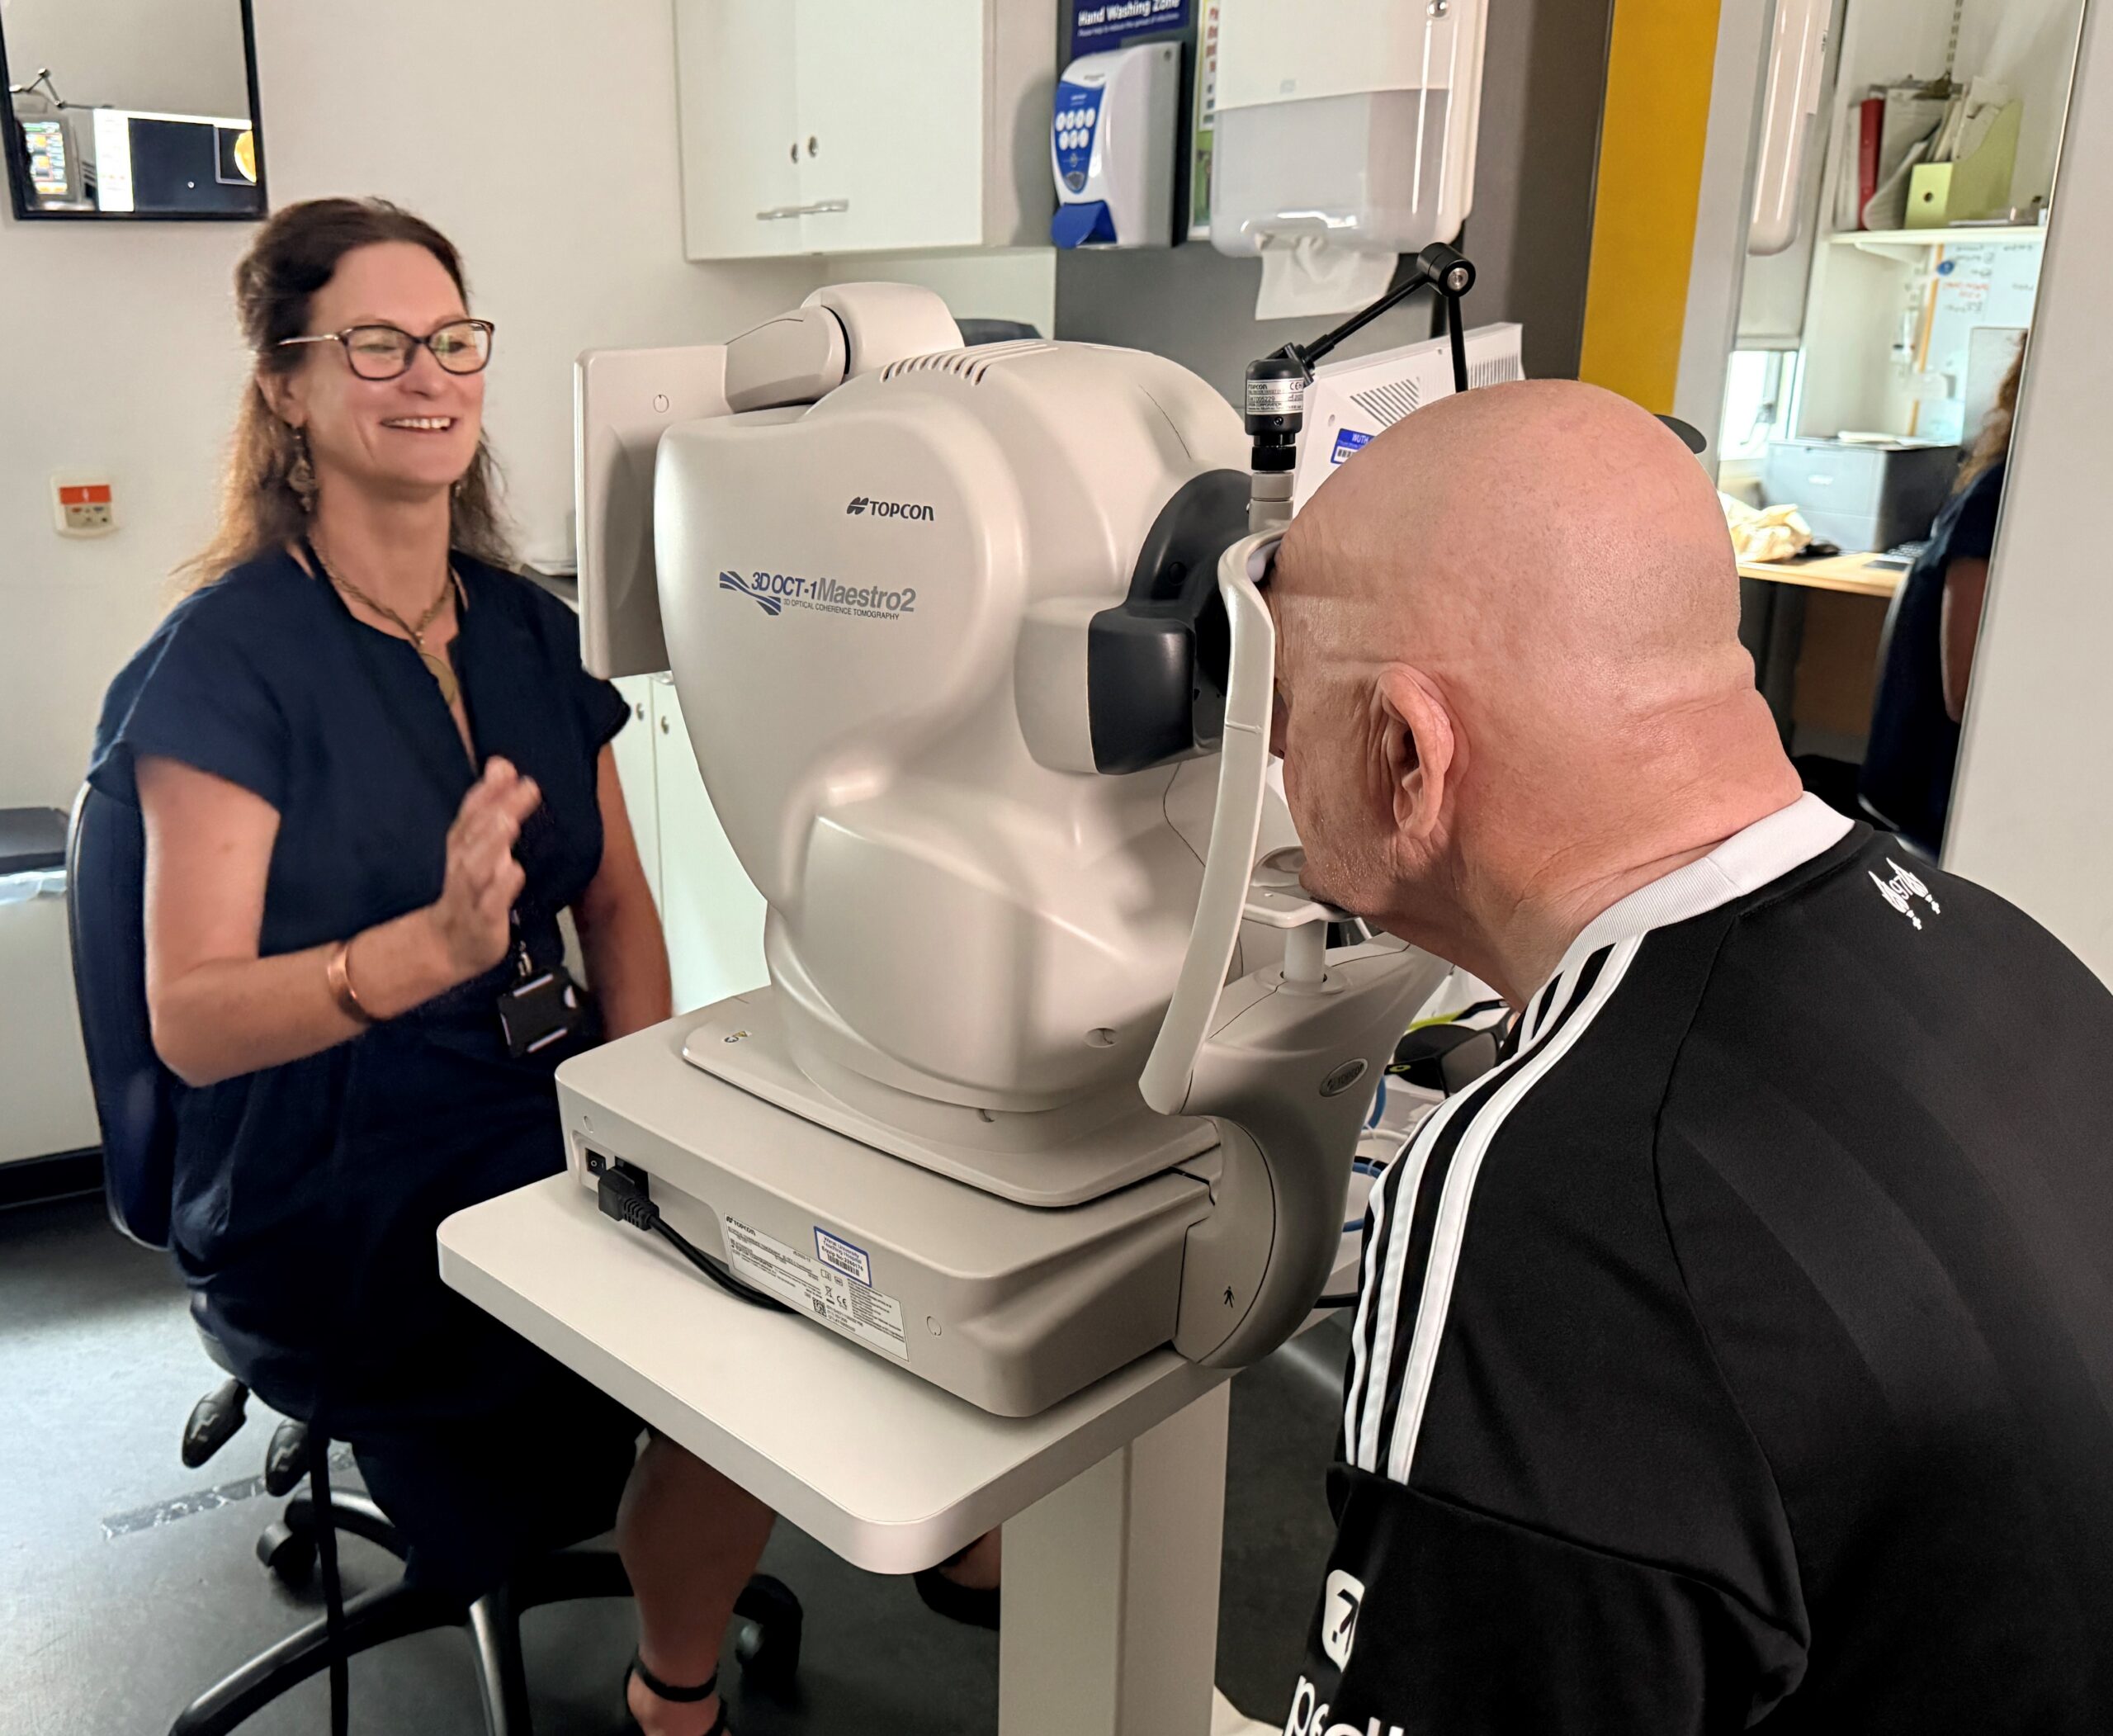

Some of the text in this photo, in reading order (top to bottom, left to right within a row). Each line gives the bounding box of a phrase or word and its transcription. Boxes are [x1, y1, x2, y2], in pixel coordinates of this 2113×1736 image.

[1078, 6, 1106, 26] Hand
[1106, 0, 1151, 21] Washing
[869, 500, 934, 521] TOPCON
[817, 577, 916, 613] Maestro2
[792, 599, 814, 610] OPTICAL
[815, 603, 852, 615] COHERENCE
[853, 608, 900, 620] TOMOGRAPHY
